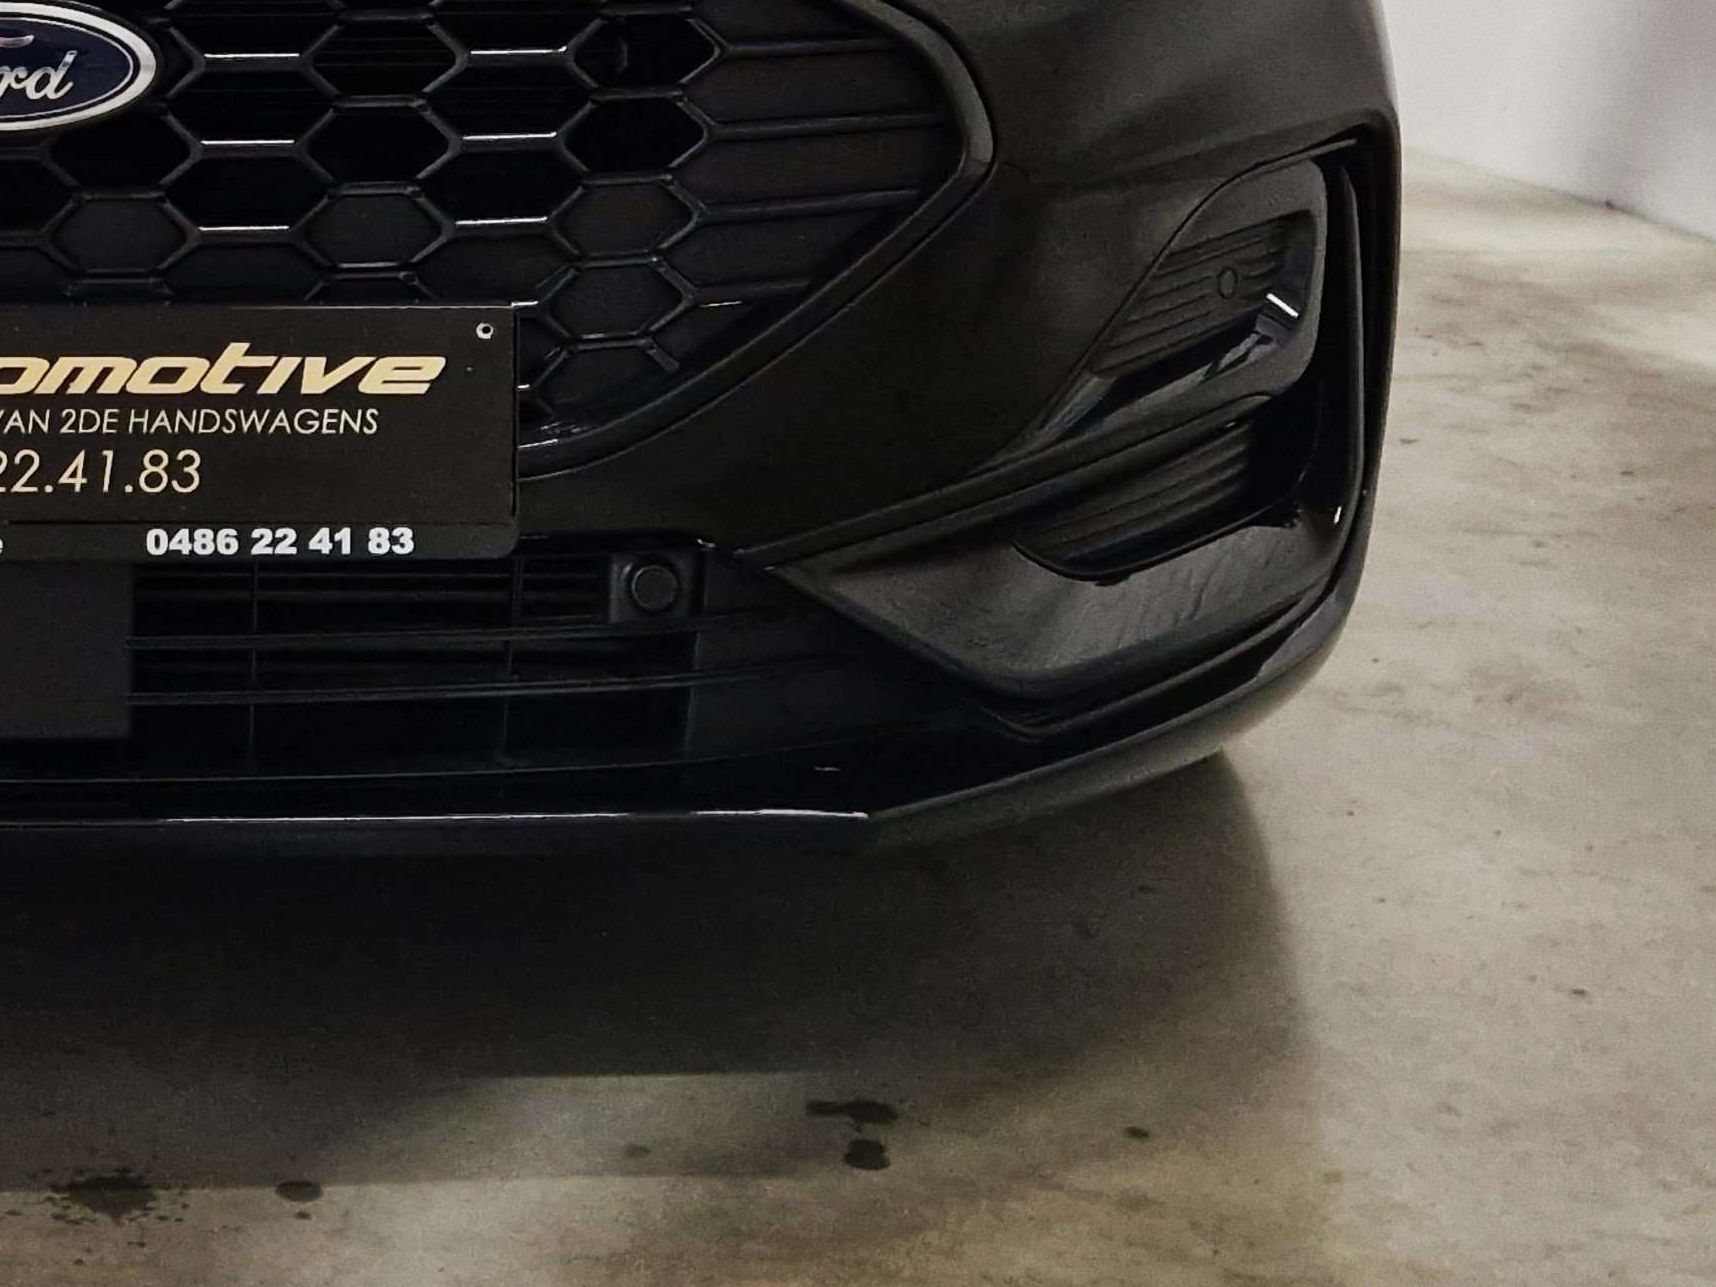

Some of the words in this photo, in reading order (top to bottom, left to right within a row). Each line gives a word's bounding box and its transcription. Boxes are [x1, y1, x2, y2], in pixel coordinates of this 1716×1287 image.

[59, 407, 119, 434] 2DE
[127, 407, 380, 435] HANDSWAGENS
[145, 527, 240, 556] 0486
[250, 527, 298, 555] 22
[308, 526, 353, 555] 41
[366, 526, 415, 555] 83
